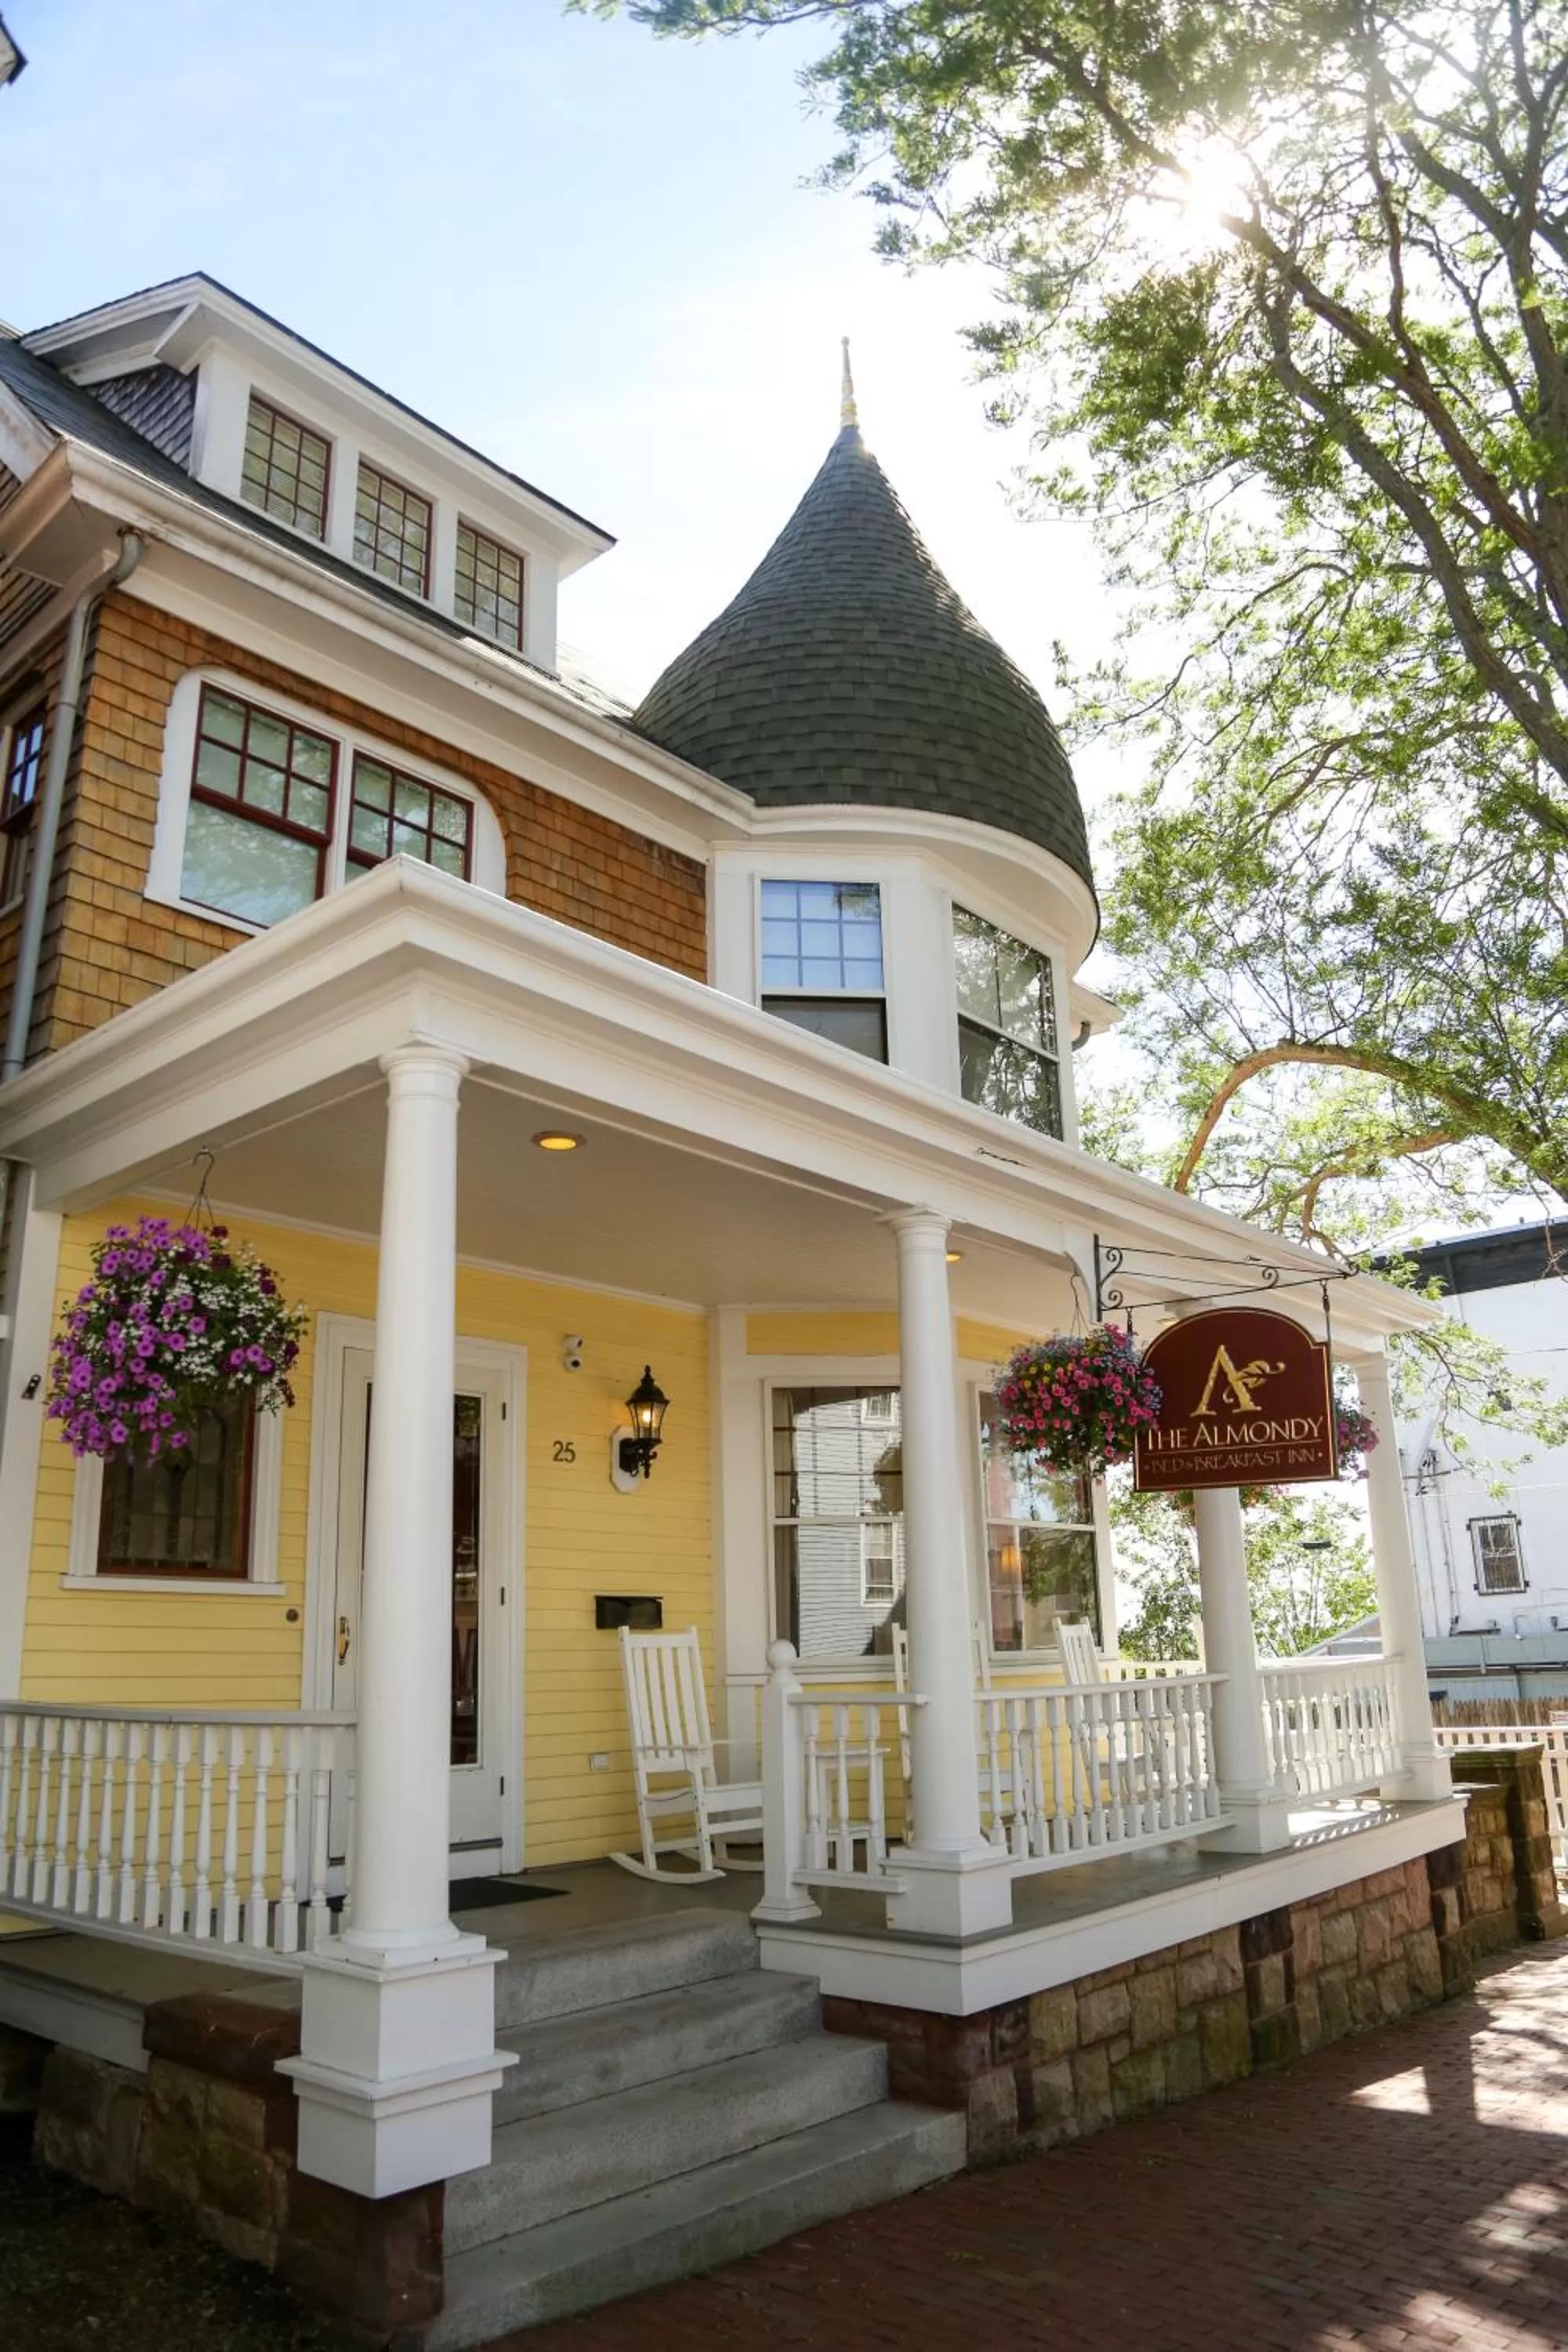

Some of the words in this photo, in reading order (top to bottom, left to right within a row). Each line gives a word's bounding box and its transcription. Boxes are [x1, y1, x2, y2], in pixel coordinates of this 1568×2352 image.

[1192, 1417, 1323, 1447] ALMONDY
[553, 1440, 575, 1463] 25
[1288, 1447, 1316, 1465] INN
